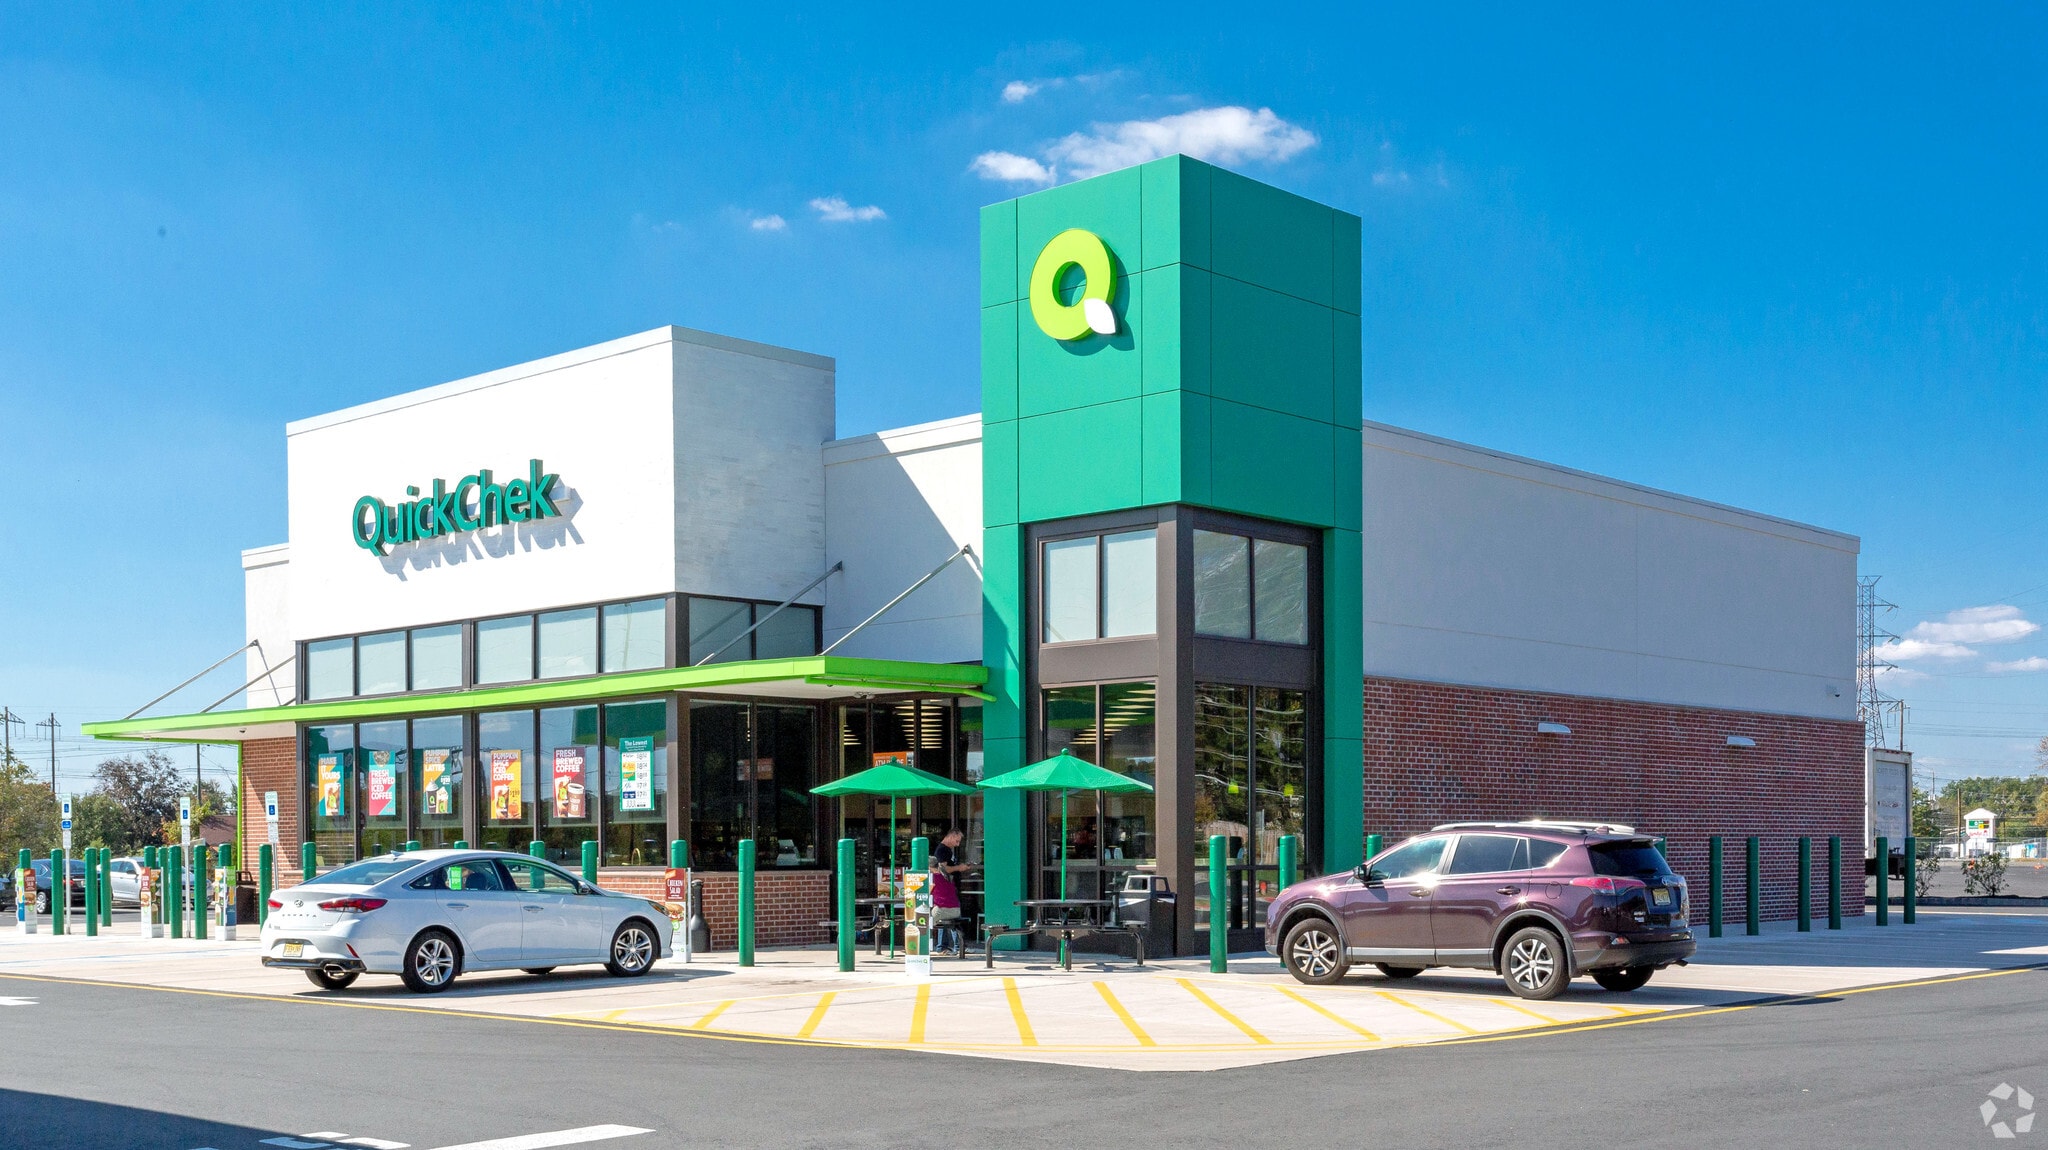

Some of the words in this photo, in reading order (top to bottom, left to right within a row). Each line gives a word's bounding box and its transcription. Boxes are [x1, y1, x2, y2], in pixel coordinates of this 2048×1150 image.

[1029, 228, 1117, 341] Q
[353, 459, 562, 557] QuickChek
[493, 759, 509, 767] SPICE
[556, 757, 583, 765] BREWED
[425, 763, 445, 771] LATTES
[322, 771, 340, 779] YOURS
[371, 777, 395, 785] BREWED
[371, 784, 384, 792] ICED
[371, 792, 393, 800] COFFEE
[669, 886, 681, 894] SALAD
